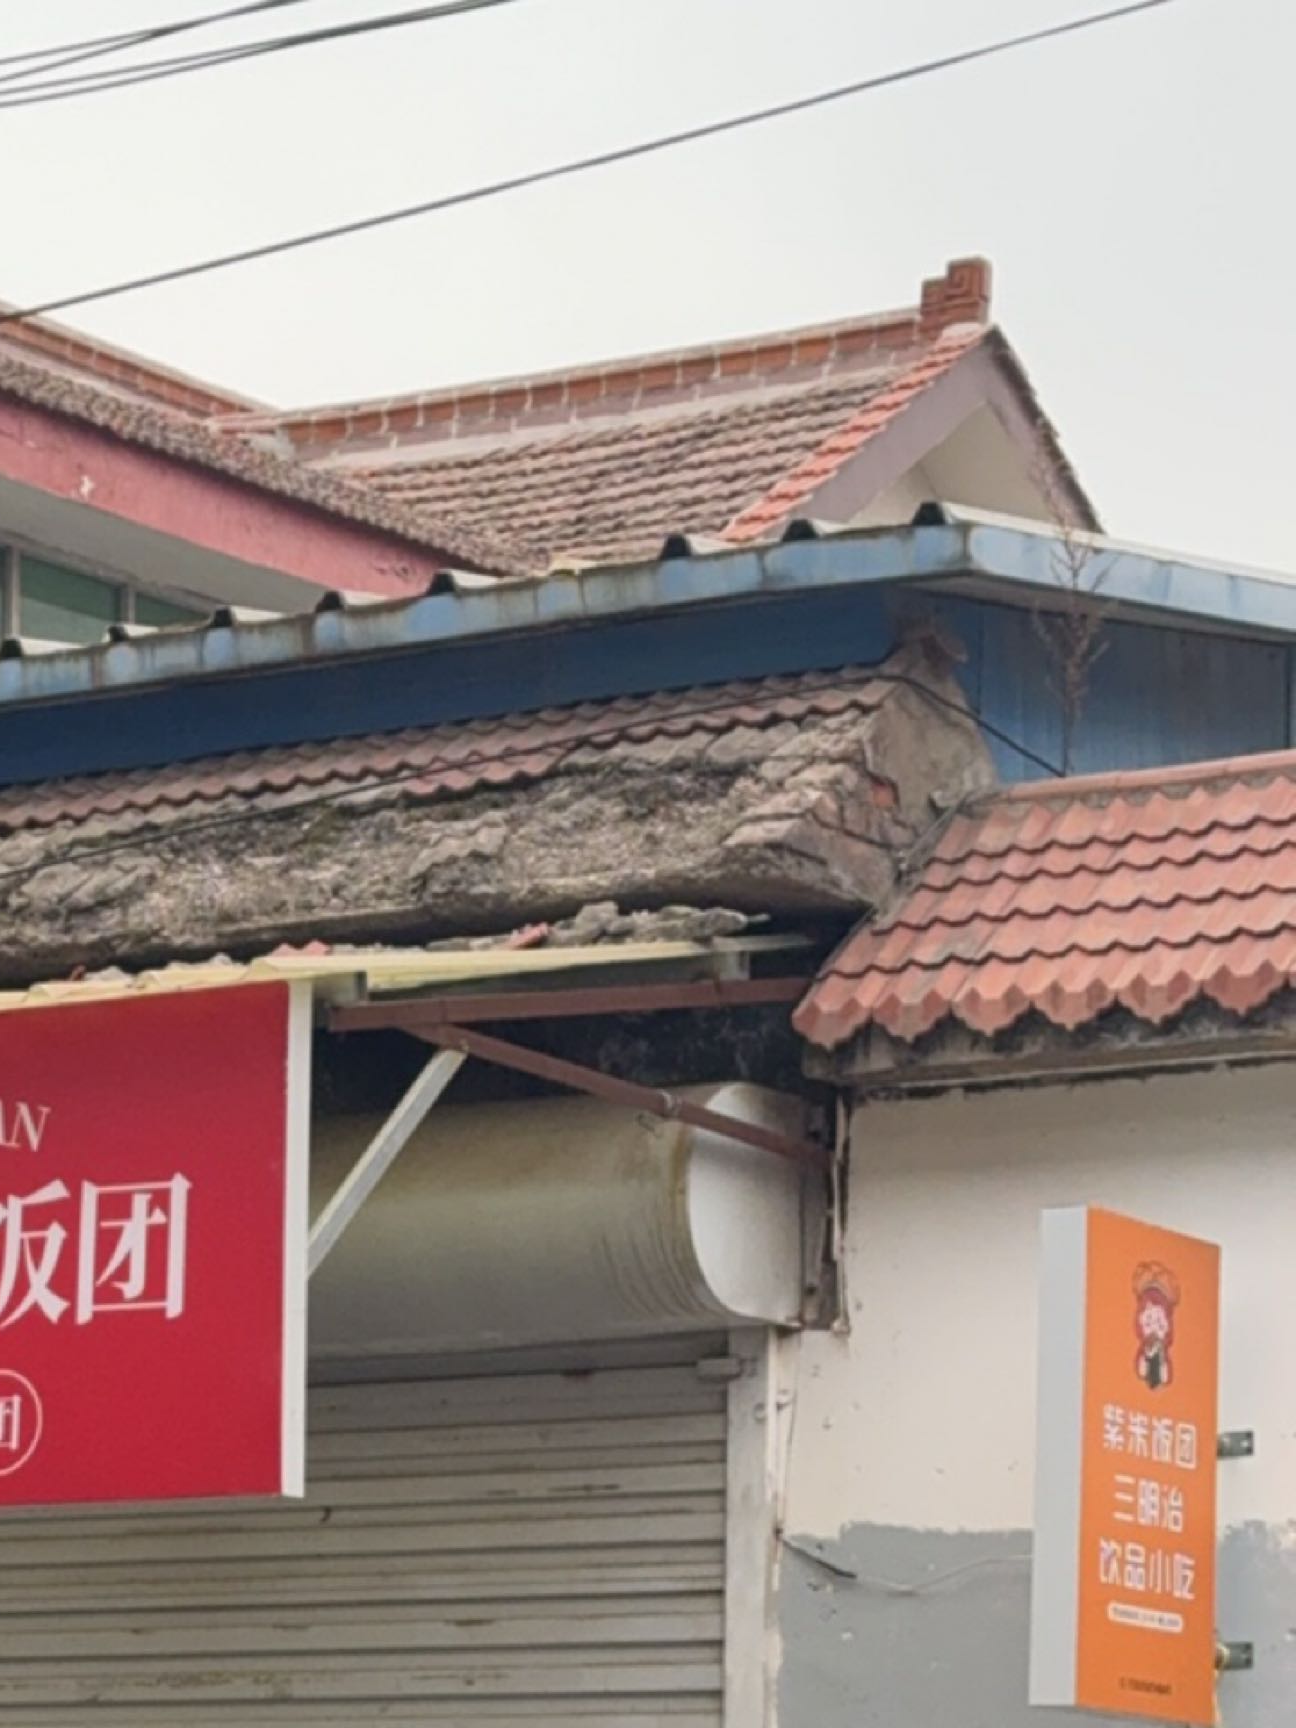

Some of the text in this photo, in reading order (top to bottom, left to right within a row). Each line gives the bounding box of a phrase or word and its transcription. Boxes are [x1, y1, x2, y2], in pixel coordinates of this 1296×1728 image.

[1103, 1404, 1197, 1469] 紫米饭团
[1113, 1474, 1184, 1532] 三明治
[1099, 1537, 1196, 1600] 饮品小吃
